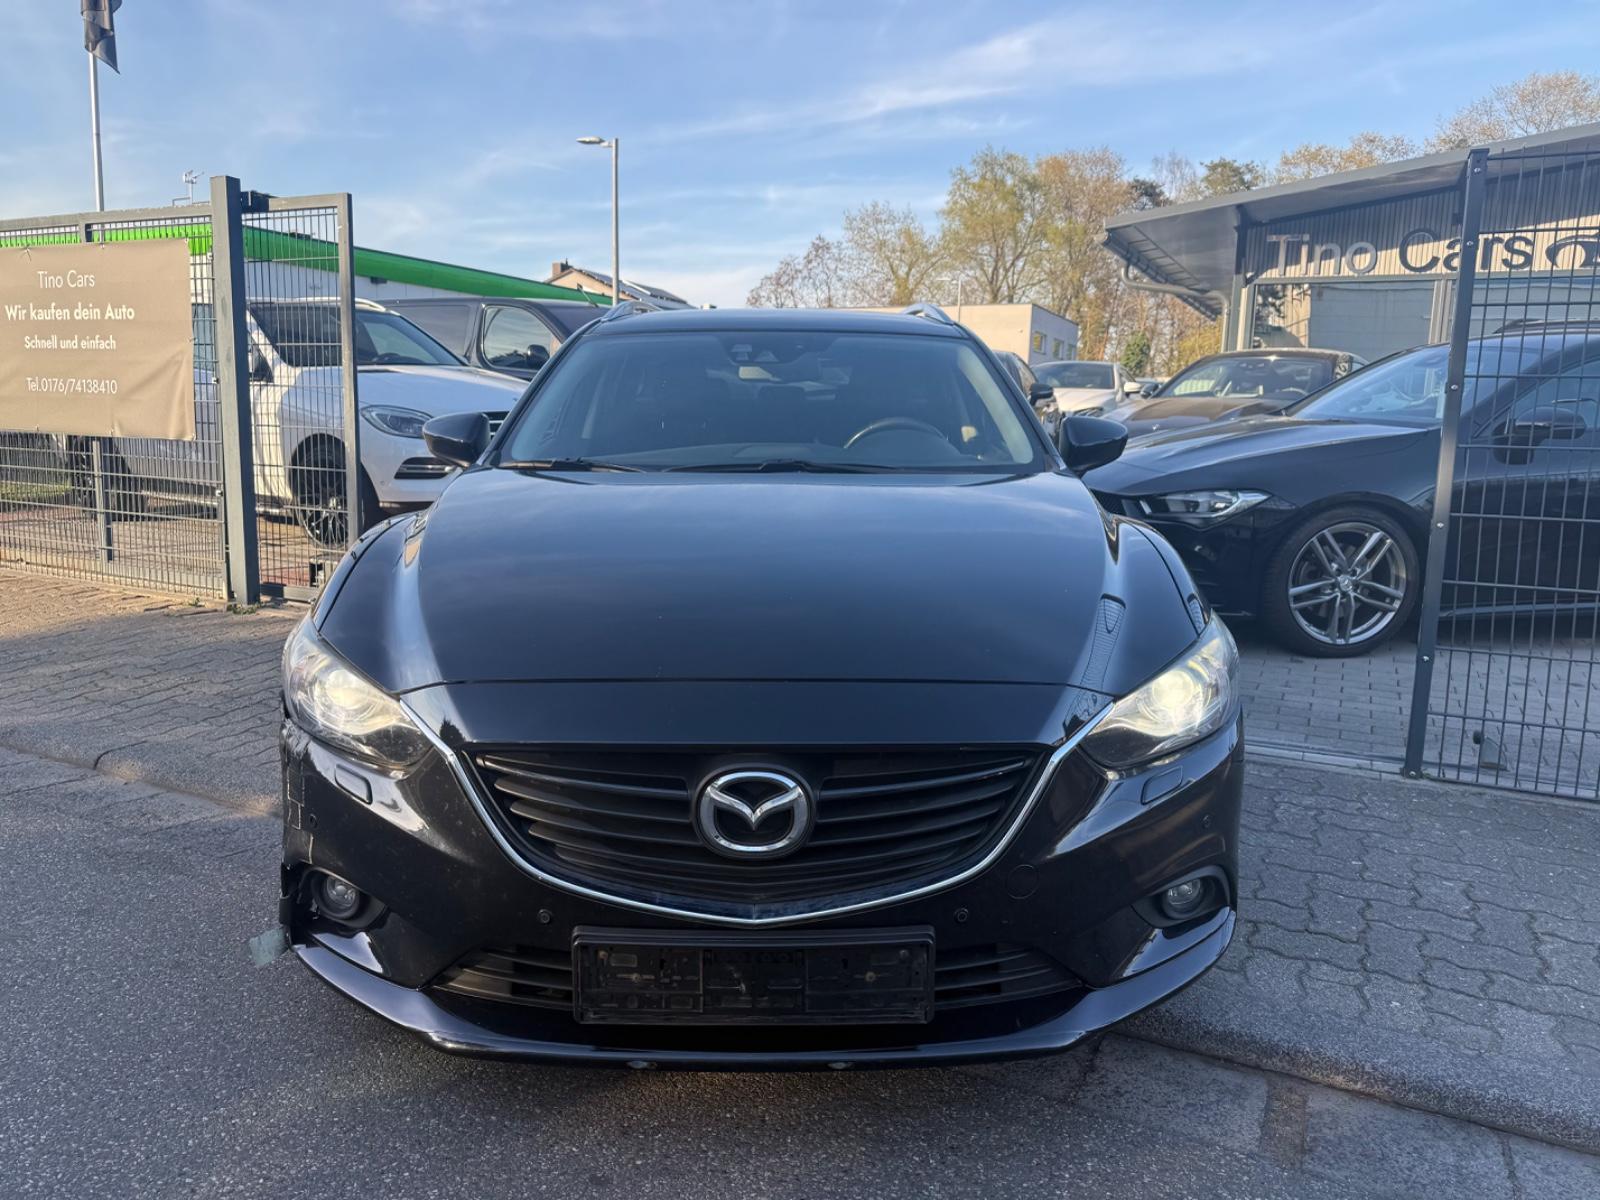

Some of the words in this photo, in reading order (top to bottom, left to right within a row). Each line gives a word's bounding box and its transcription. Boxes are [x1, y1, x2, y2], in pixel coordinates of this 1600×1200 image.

[1266, 233, 1378, 276] Tino
[1400, 228, 1535, 273] Cars
[37, 270, 64, 289] Tino
[67, 269, 96, 288] Cars
[4, 304, 27, 321] Wir
[29, 302, 71, 321] kaufen
[73, 301, 101, 320] dein
[104, 302, 136, 320] Auto
[24, 334, 58, 350] Schnell
[60, 334, 78, 349] und
[80, 334, 117, 350] einfach
[26, 376, 118, 395] Tel.0176/74138410
